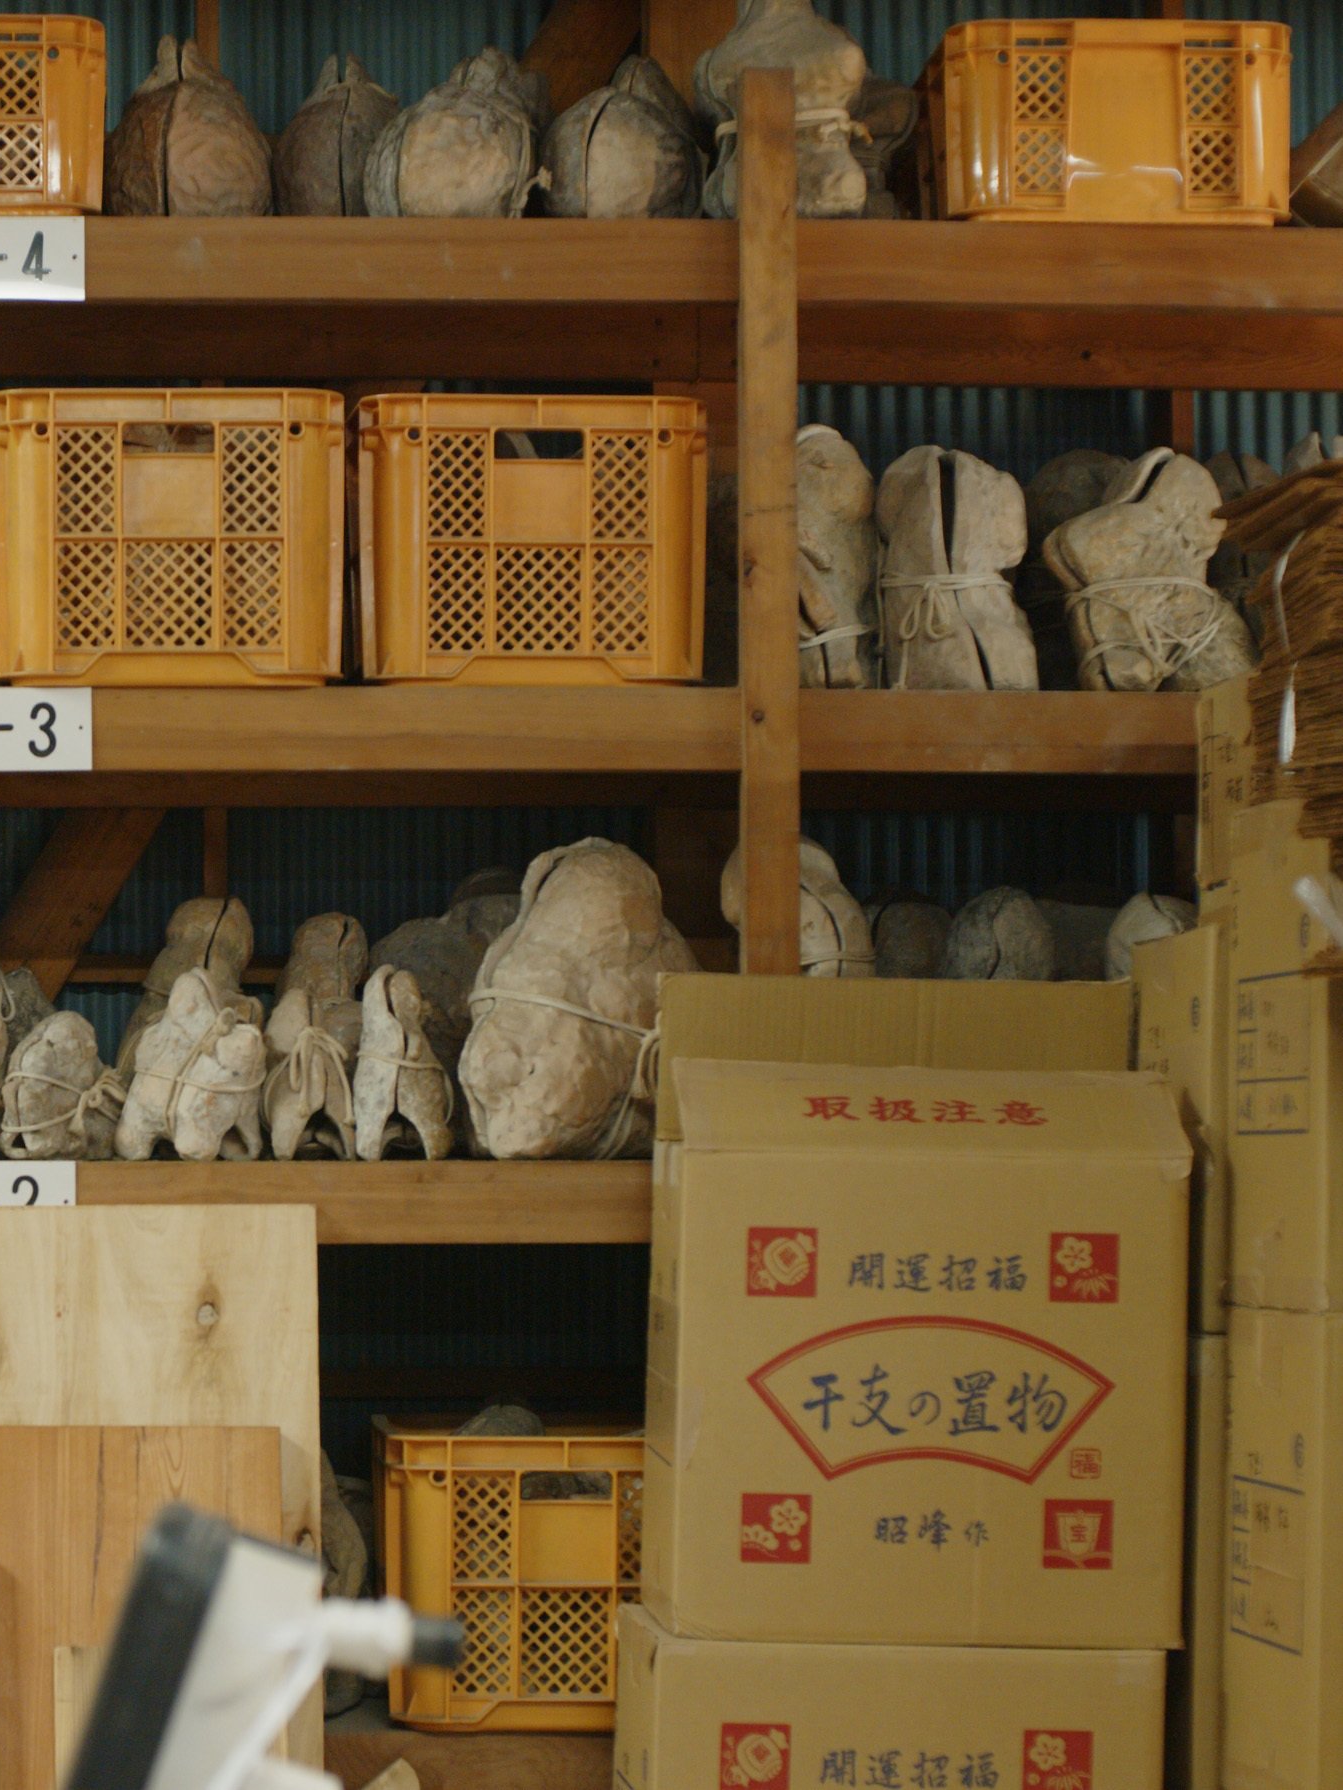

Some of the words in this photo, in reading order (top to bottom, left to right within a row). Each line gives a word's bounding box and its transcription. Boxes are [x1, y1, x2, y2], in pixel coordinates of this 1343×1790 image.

[803, 1095, 1049, 1126] 取扱注意
[847, 1252, 1029, 1292] 開運招福
[803, 1363, 1068, 1436] 干支の置物
[819, 1749, 1000, 1789] 開運招福
